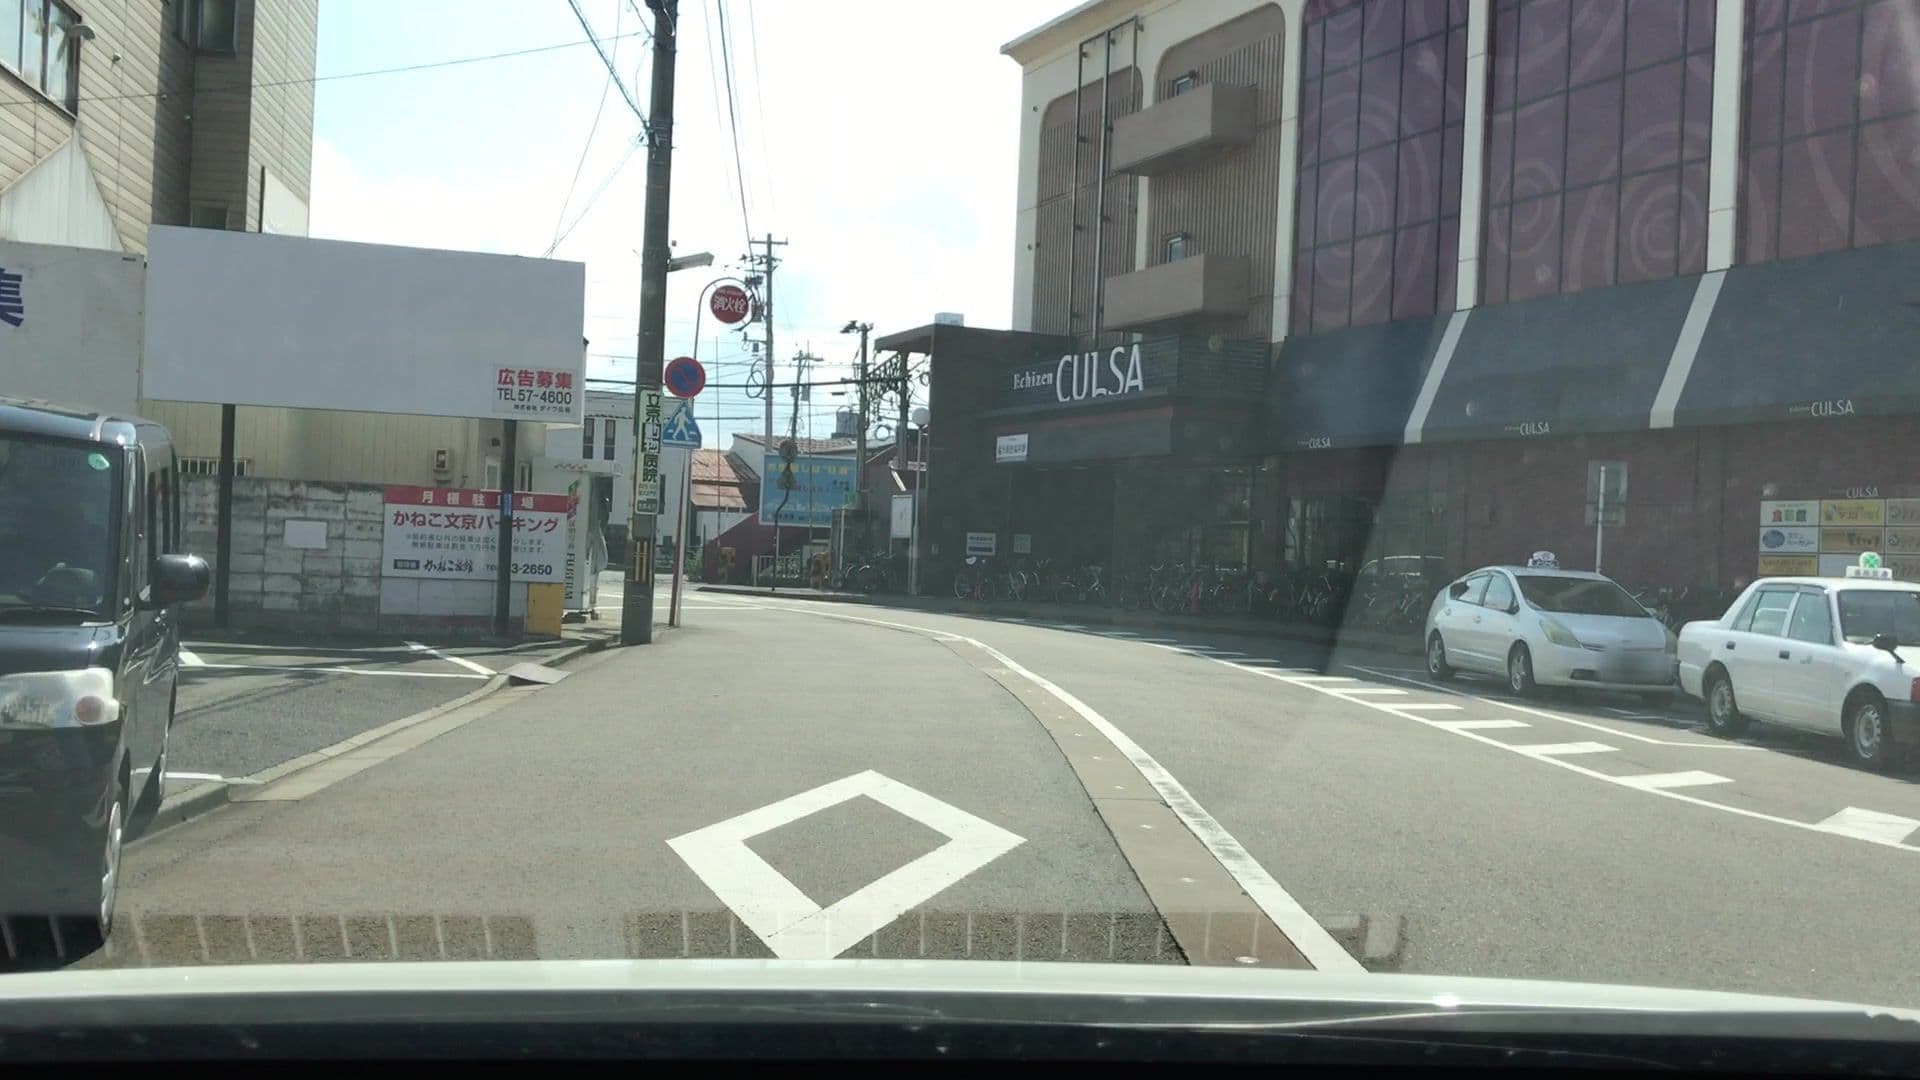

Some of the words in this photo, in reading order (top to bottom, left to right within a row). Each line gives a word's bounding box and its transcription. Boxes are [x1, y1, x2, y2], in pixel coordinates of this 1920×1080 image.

[713, 296, 747, 314] 消火栓
[497, 368, 573, 389] 広告募集
[1013, 371, 1054, 389] Echizen
[1056, 344, 1144, 402] CULSA
[1811, 400, 1854, 416] CULSA
[1519, 422, 1550, 435] CULSA
[422, 490, 535, 510] 月極駐場
